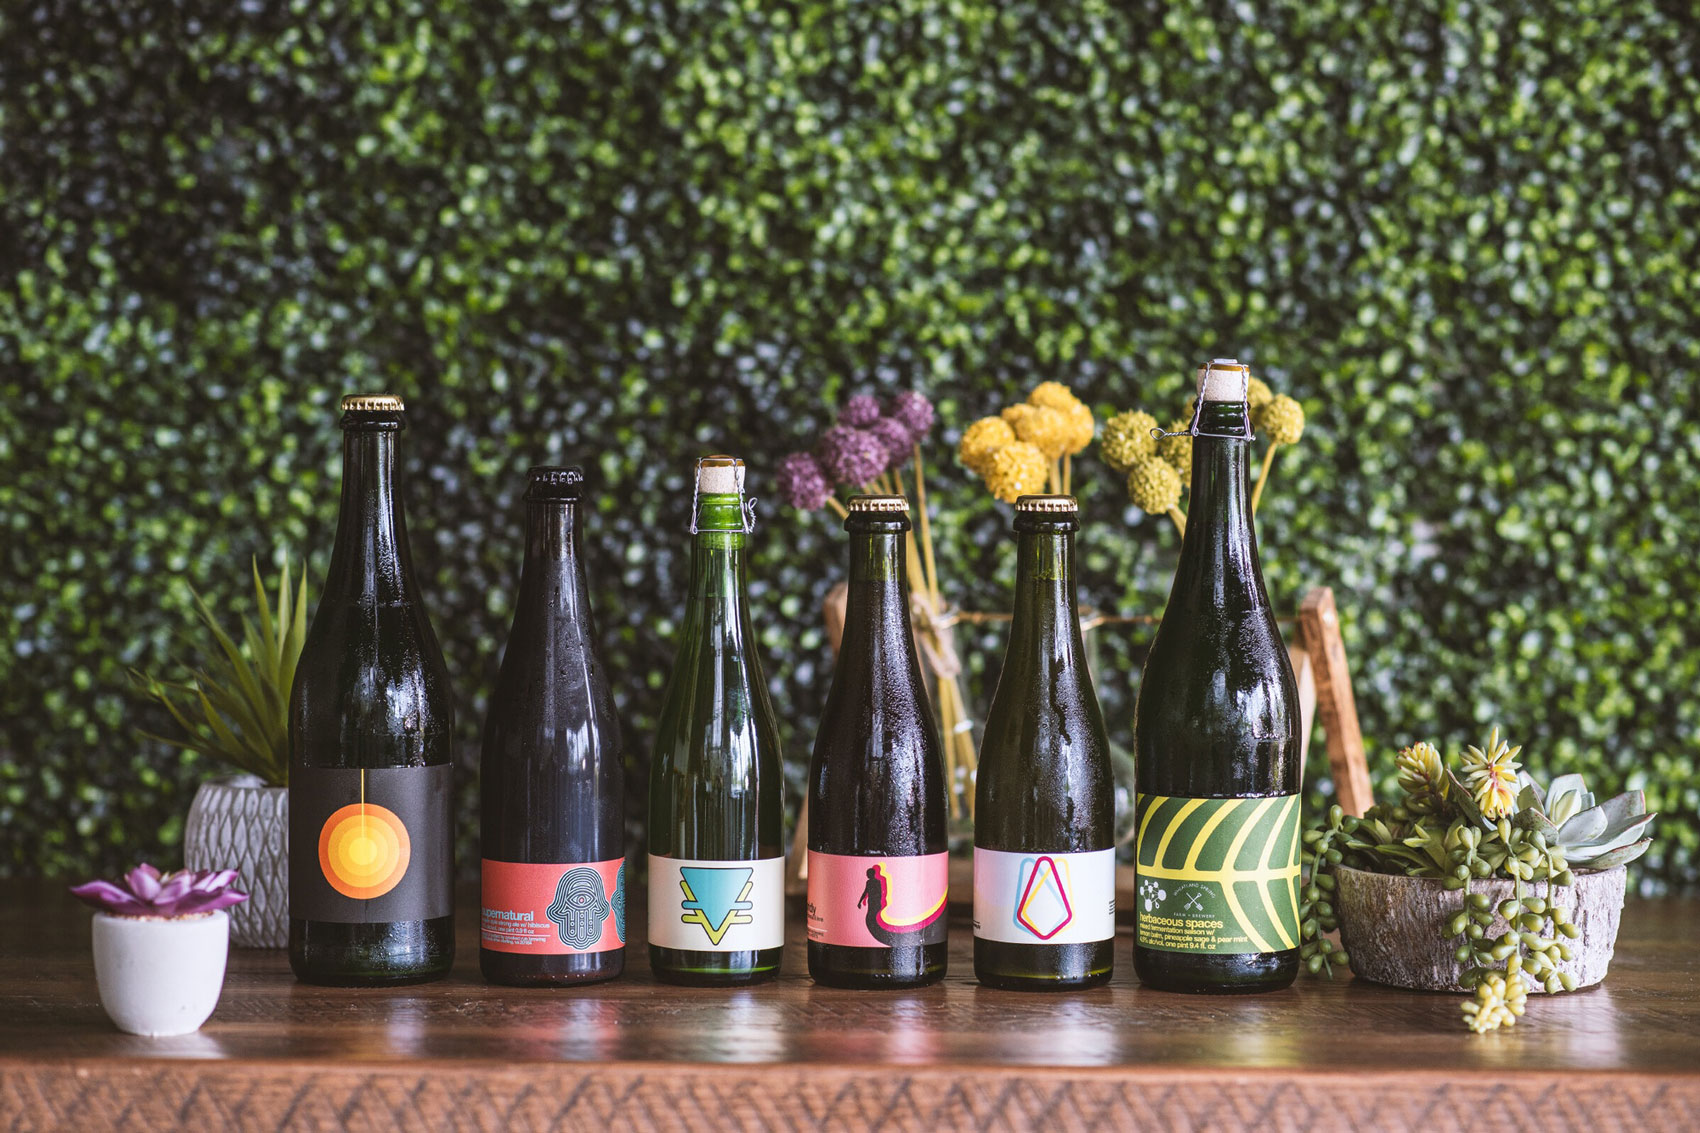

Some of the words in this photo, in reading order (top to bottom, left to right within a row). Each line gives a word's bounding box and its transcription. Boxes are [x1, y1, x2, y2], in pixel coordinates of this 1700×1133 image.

[482, 907, 534, 922] upernatural
[1140, 912, 1184, 927] herbaceous
[1186, 920, 1224, 930] spaces
[1151, 924, 1183, 934] fermentation
[1164, 934, 1192, 942] pineapple
